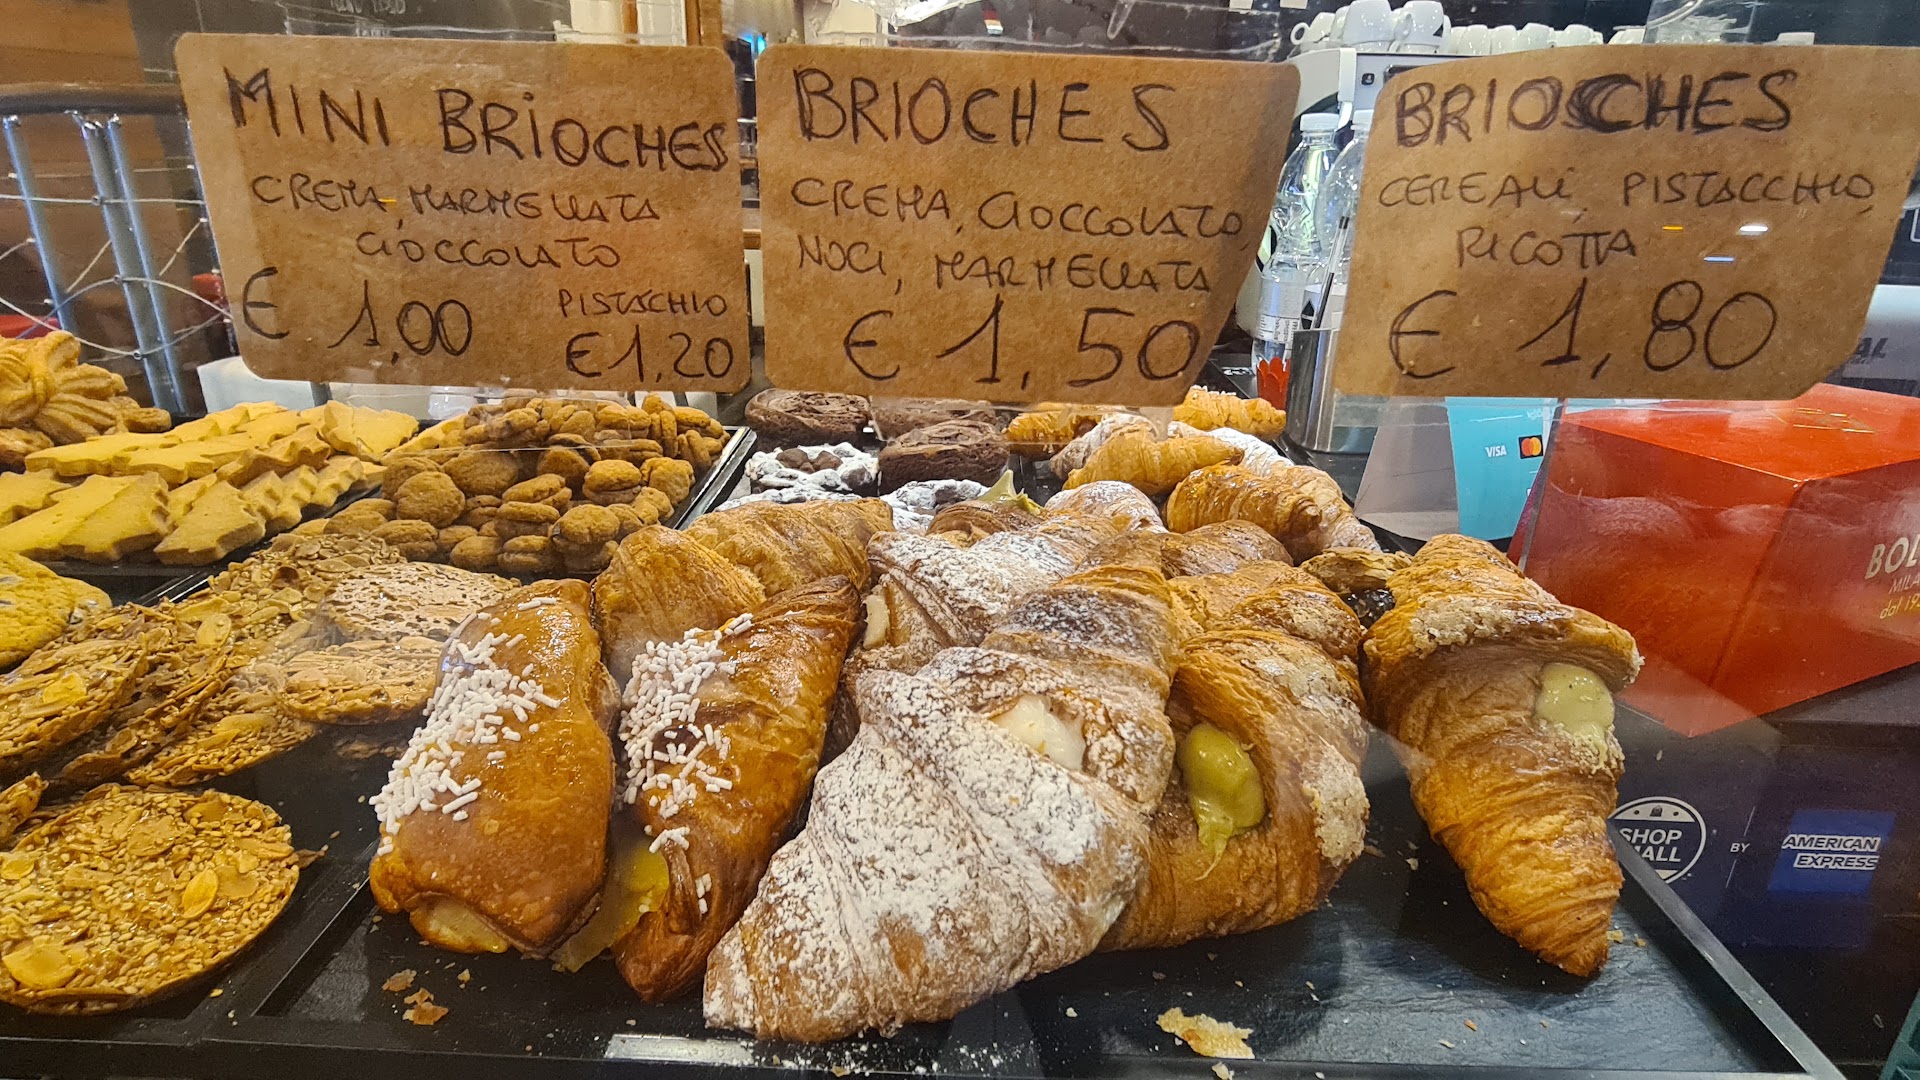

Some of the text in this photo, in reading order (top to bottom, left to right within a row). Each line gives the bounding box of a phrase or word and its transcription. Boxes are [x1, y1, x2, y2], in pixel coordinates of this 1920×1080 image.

[222, 65, 392, 147] MINI
[792, 67, 1177, 152] BRIOCHES
[408, 184, 661, 223] MARMELLATA
[791, 177, 964, 235] CREMA,
[355, 230, 622, 268] CIOCCOLATO
[1456, 226, 1638, 271] RICOTTA
[934, 250, 1211, 295] MARMELLATA
[241, 266, 474, 366] € 1,00
[1388, 290, 1458, 380] €
[843, 309, 901, 382] €
[1484, 444, 1507, 458] VISA
[1880, 592, 1920, 619] dal 19
[1619, 827, 1683, 845] SHOP
[1633, 845, 1682, 863] ALL
[1730, 842, 1750, 853] BY
[1782, 834, 1881, 852] AMERICAN
[1794, 853, 1880, 871] EXPRESS
